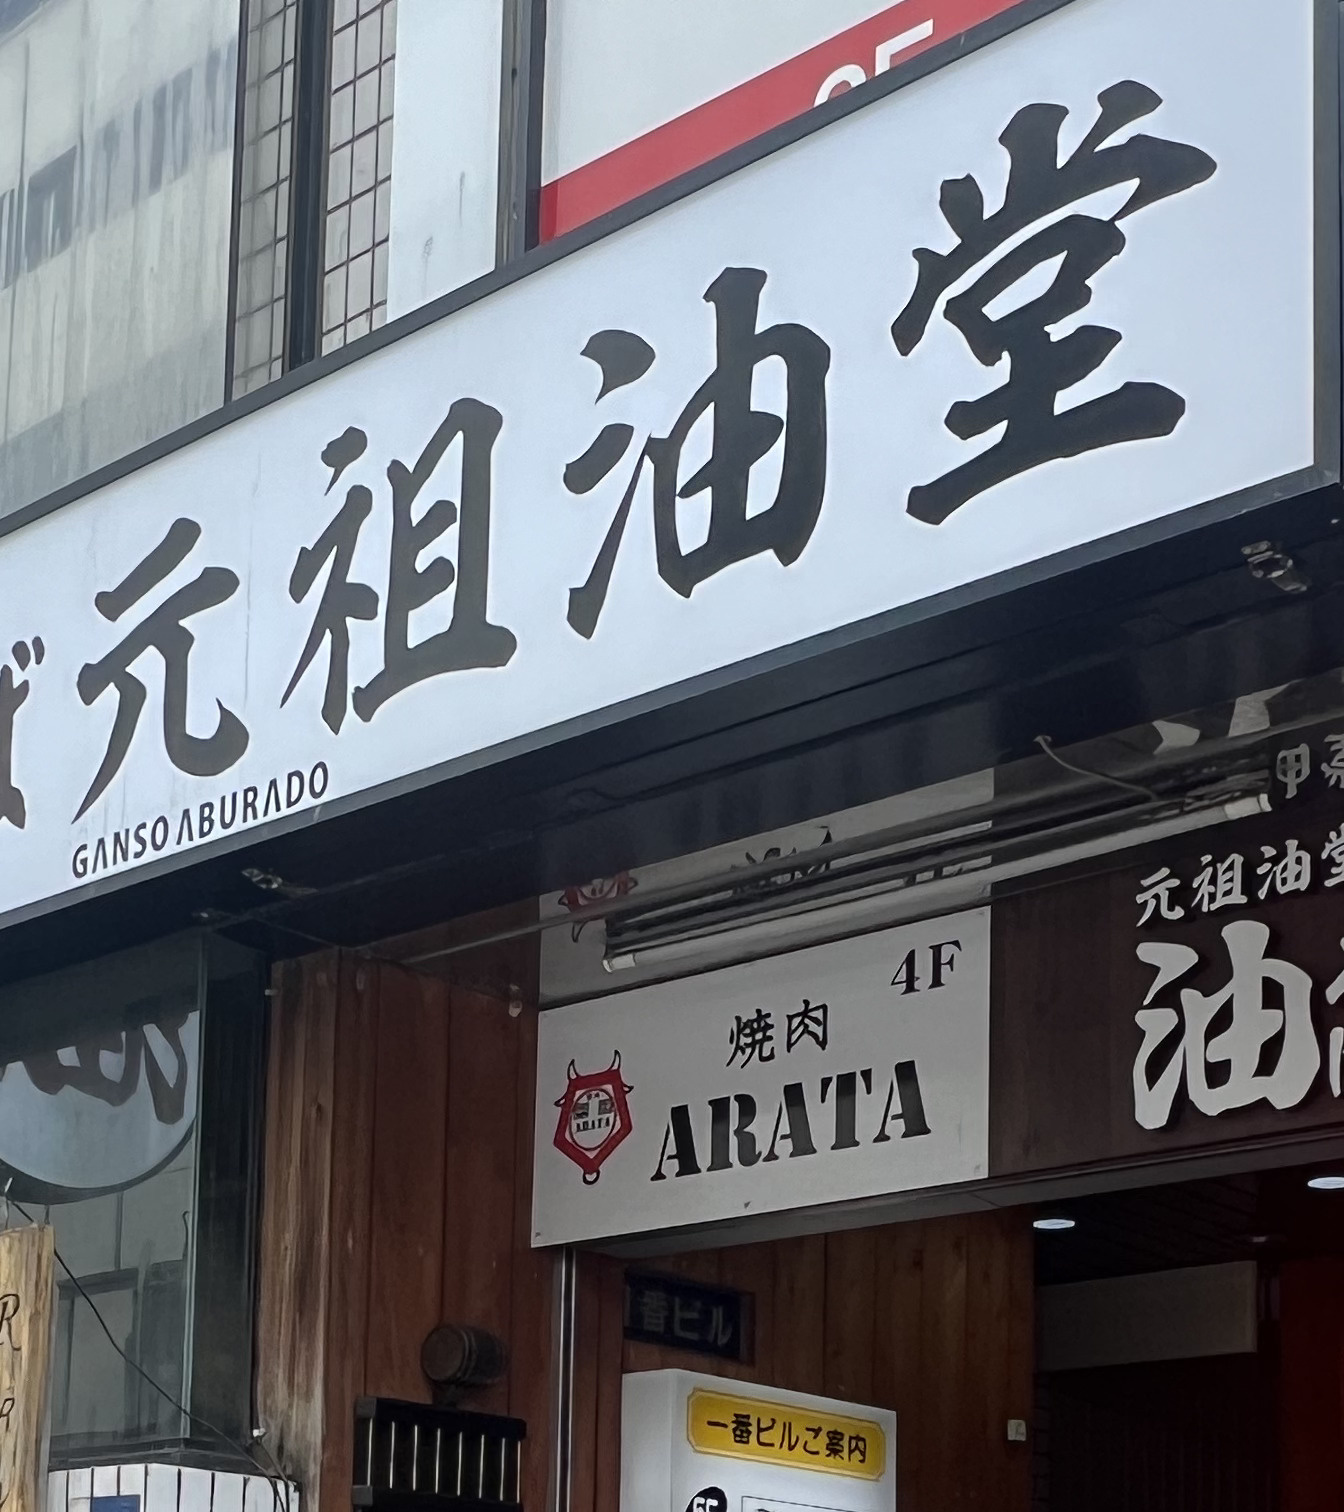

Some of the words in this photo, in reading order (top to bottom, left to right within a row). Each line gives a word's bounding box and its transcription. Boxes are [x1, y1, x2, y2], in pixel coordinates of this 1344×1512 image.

[890, 939, 962, 996] 4F
[726, 999, 829, 1069] 焼肉
[650, 1060, 932, 1182] ARATA
[707, 1413, 868, 1464] 一番ビルご案内
